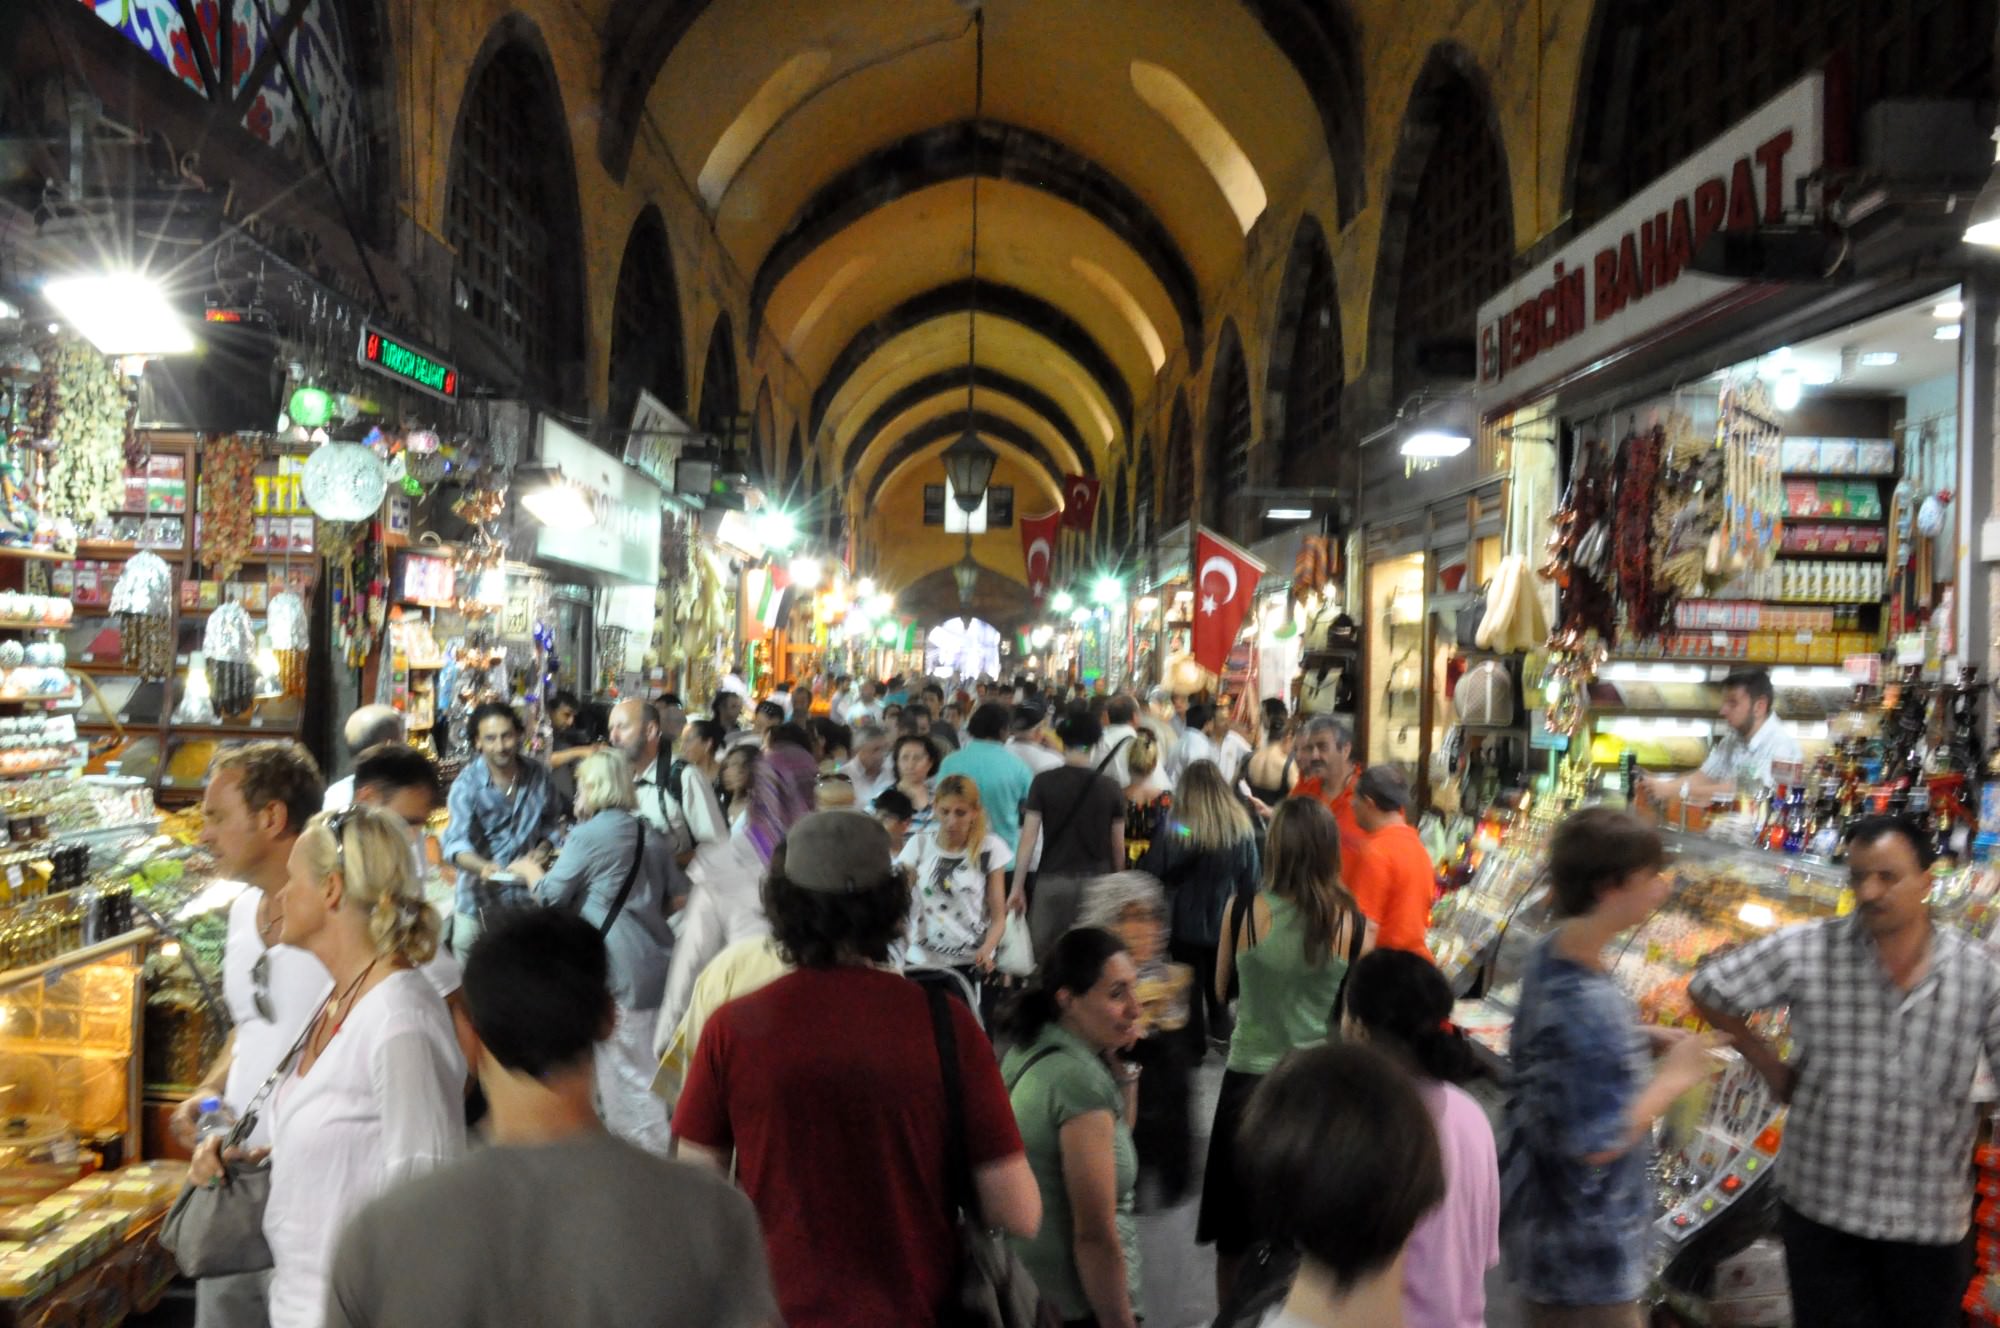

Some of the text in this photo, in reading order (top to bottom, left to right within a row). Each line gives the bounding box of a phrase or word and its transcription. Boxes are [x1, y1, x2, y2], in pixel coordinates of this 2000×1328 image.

[1594, 129, 1793, 322] BAHARAT
[382, 339, 416, 378] TURKISH
[414, 355, 446, 390] DELIGHT
